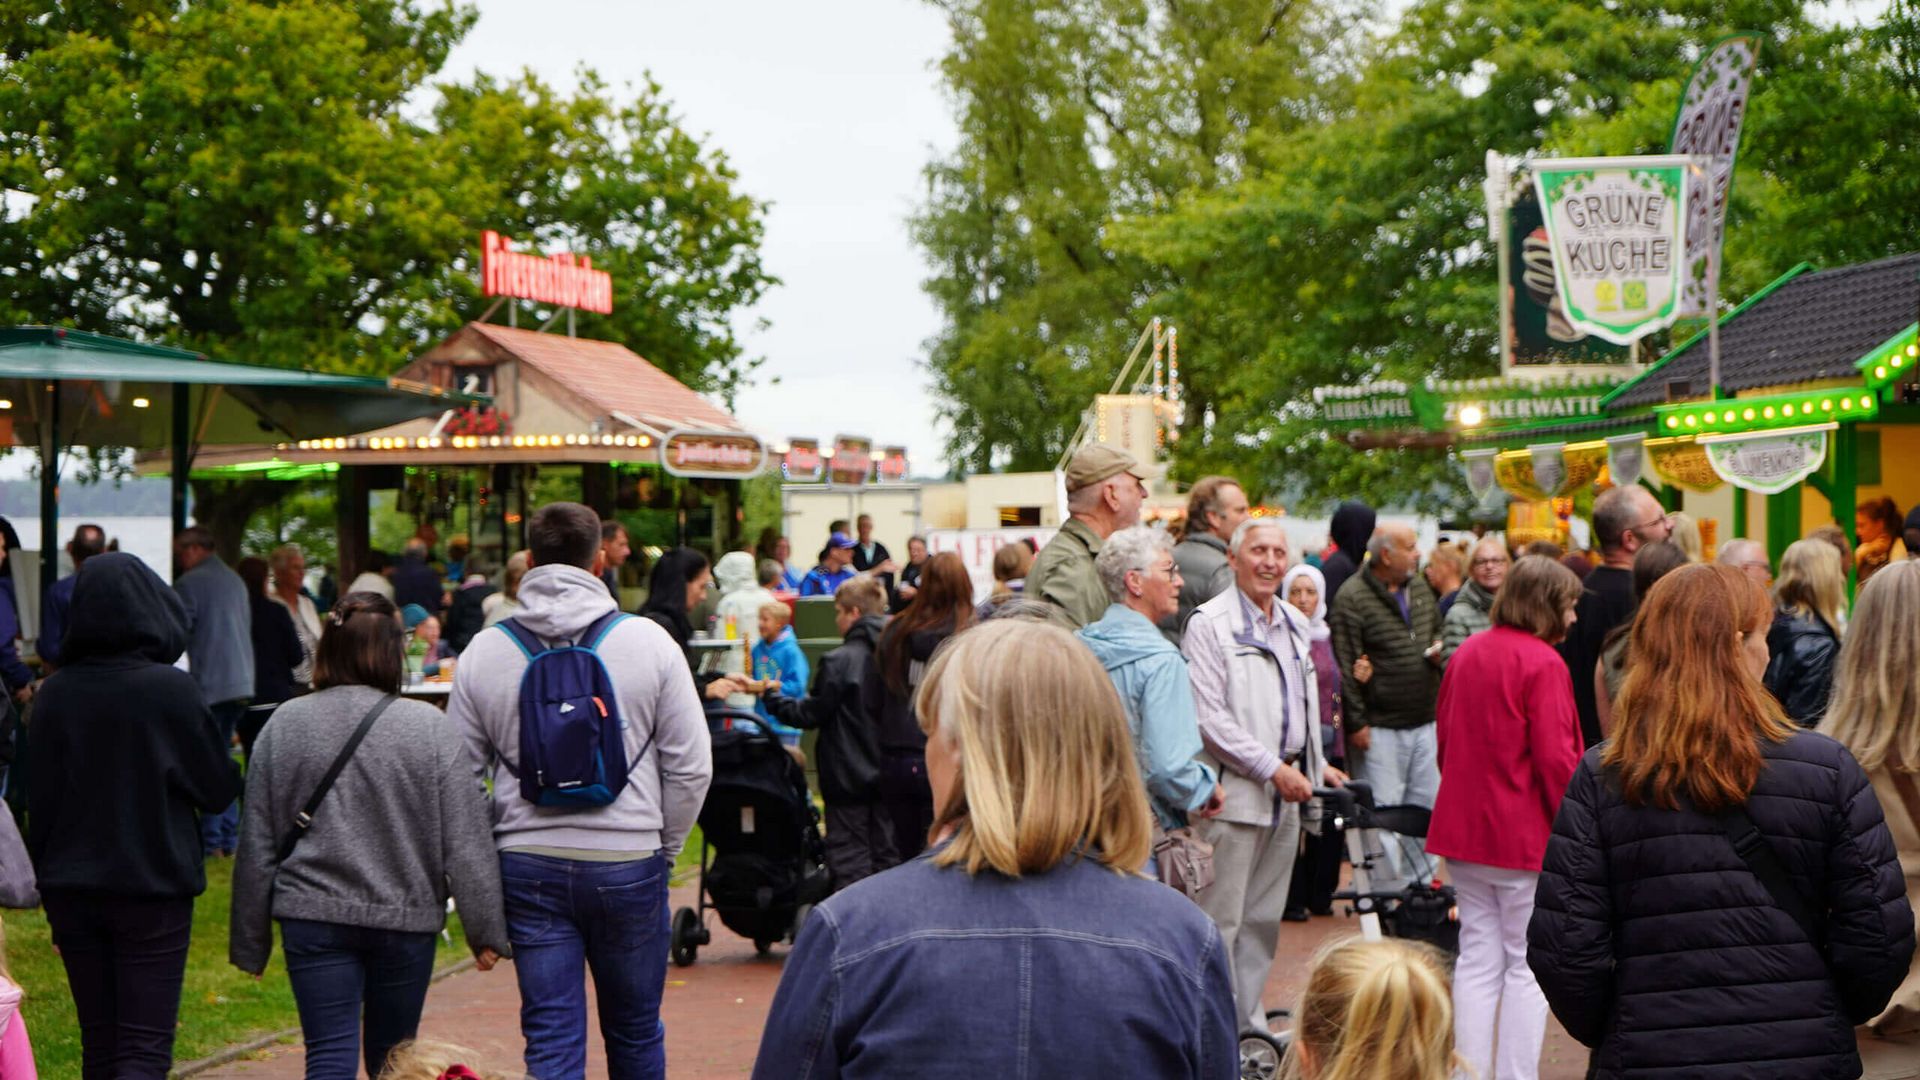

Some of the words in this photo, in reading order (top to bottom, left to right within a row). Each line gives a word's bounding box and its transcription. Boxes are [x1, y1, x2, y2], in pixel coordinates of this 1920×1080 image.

[1564, 184, 1664, 231] GRÜNE
[1566, 230, 1673, 278] KÜCHE
[1443, 396, 1601, 421] ZKERWATTE
